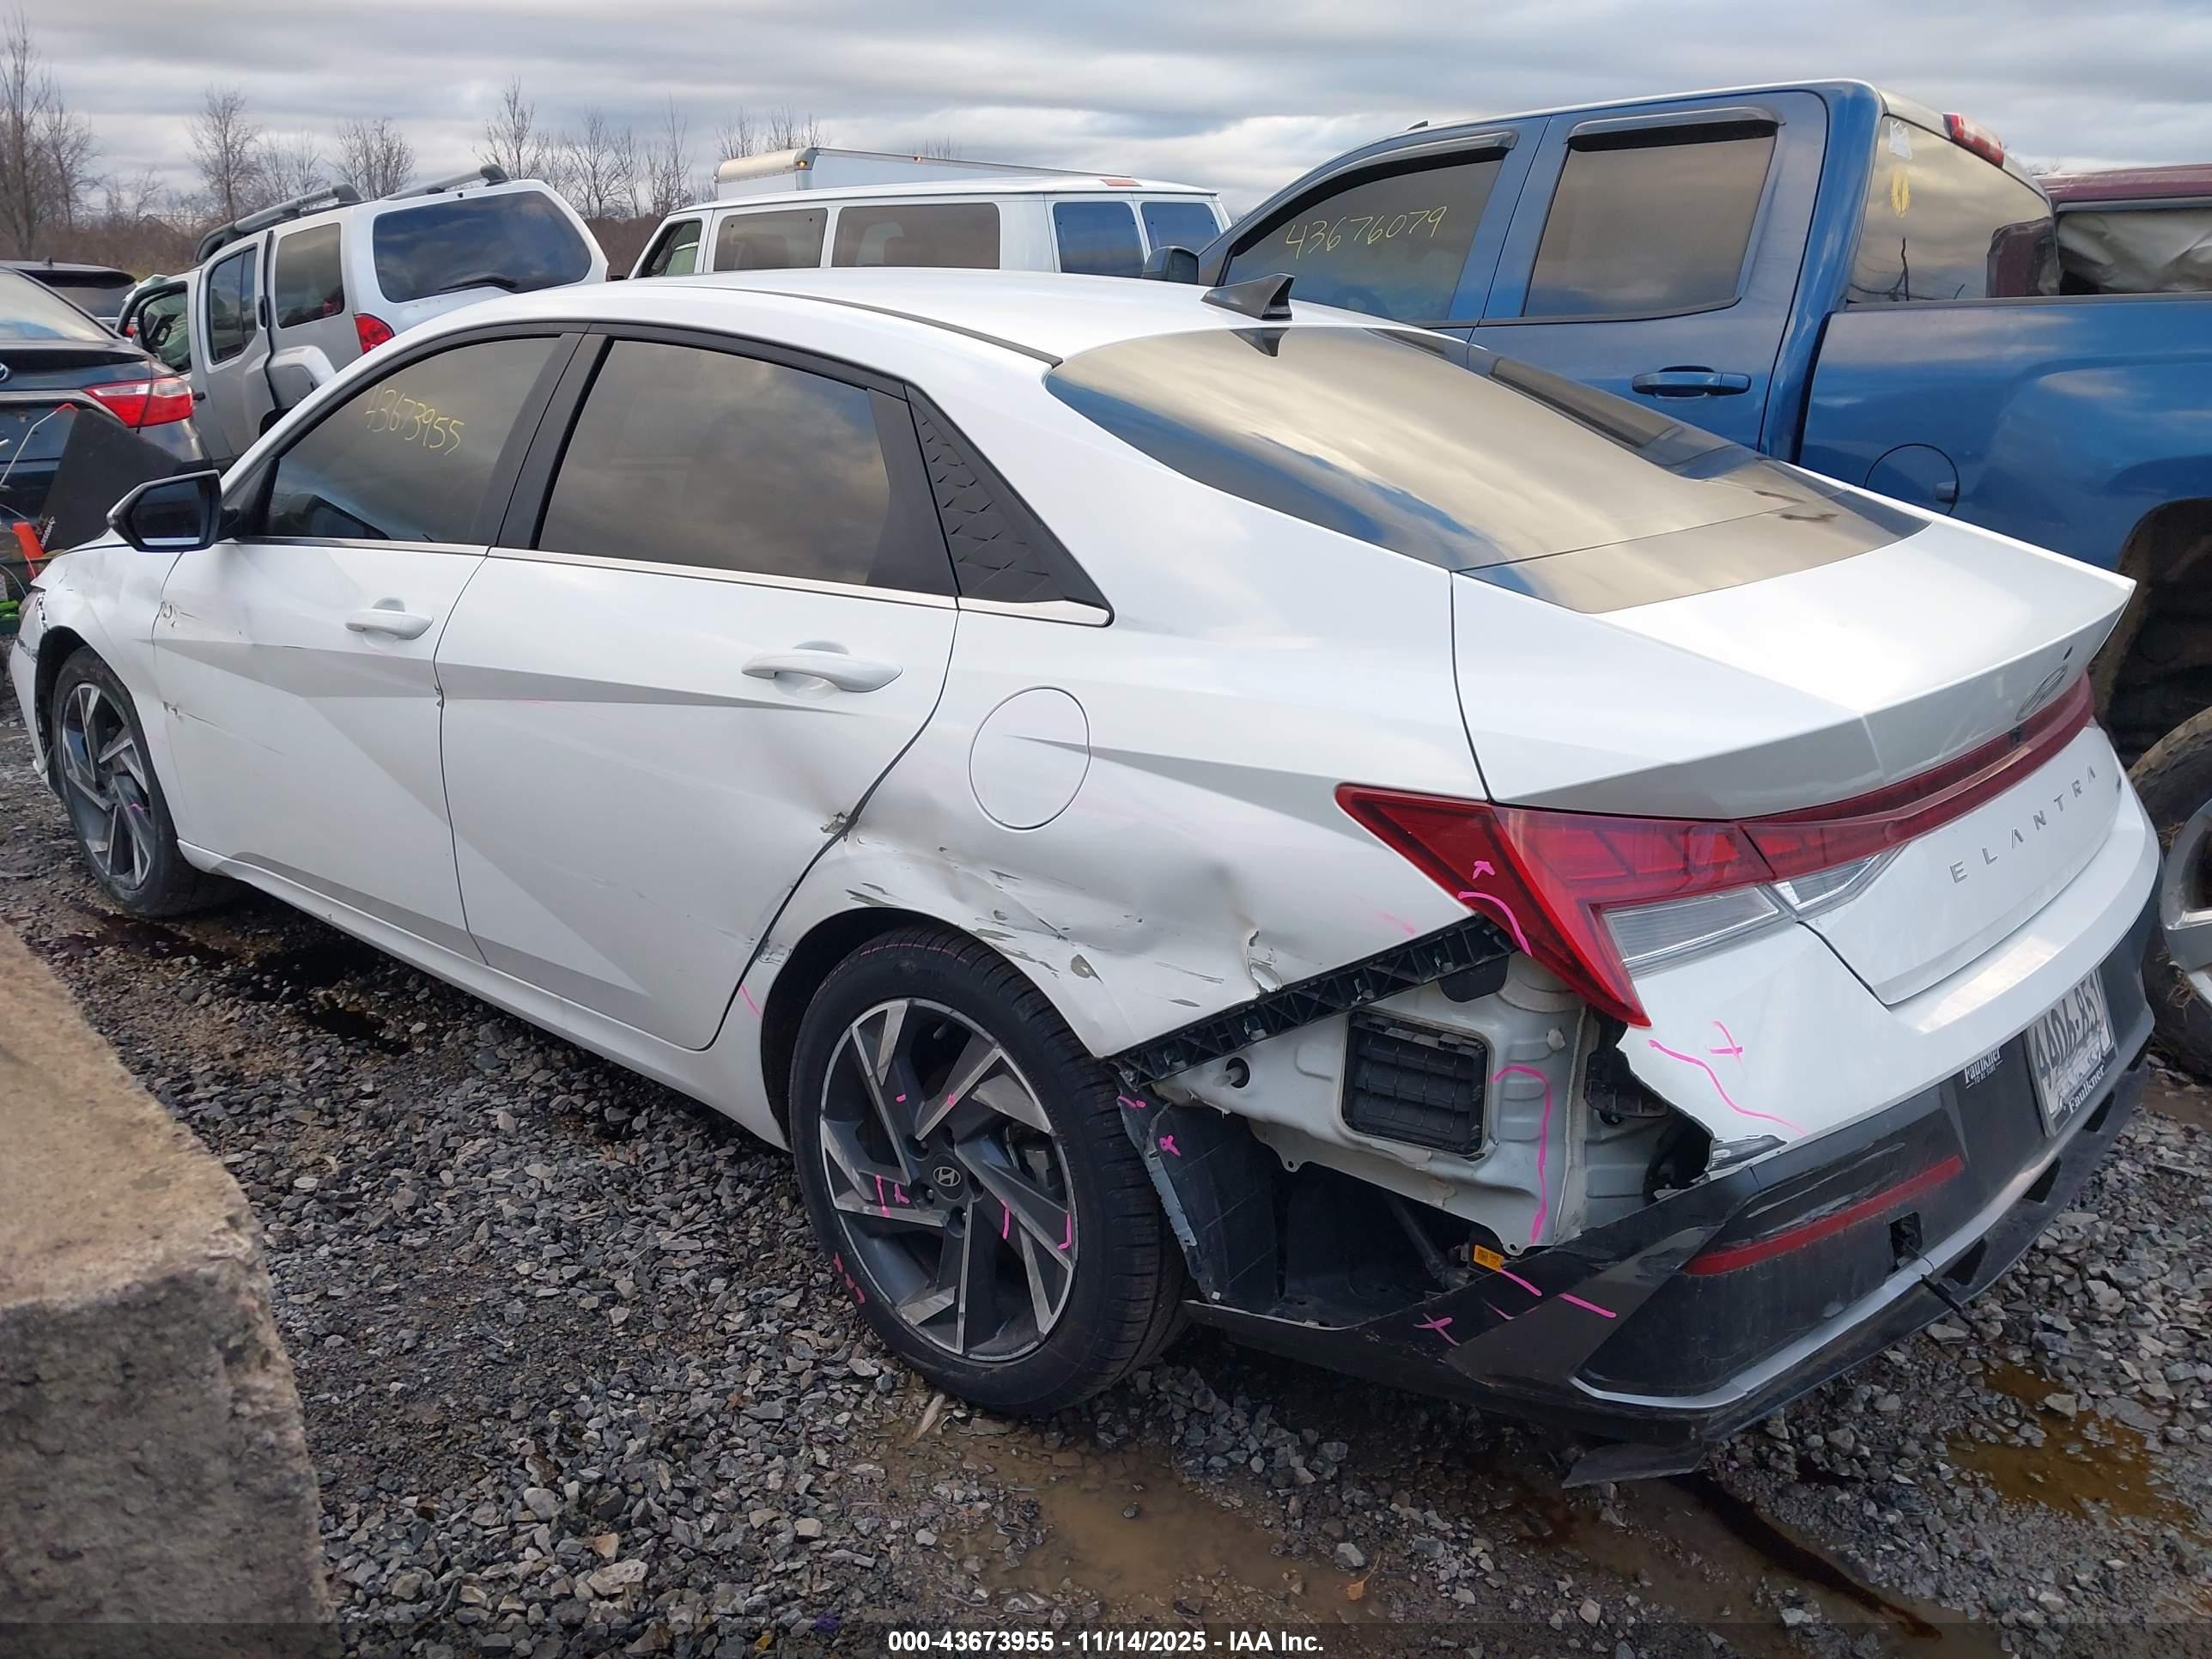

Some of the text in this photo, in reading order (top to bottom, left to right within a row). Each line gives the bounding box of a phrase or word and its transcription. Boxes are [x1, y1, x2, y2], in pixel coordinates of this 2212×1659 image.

[1285, 205, 1448, 259] 43676079
[365, 385, 465, 455] 43673955
[1949, 765, 2096, 884] ELANTRA
[2068, 1064, 2106, 1114] Faulkner
